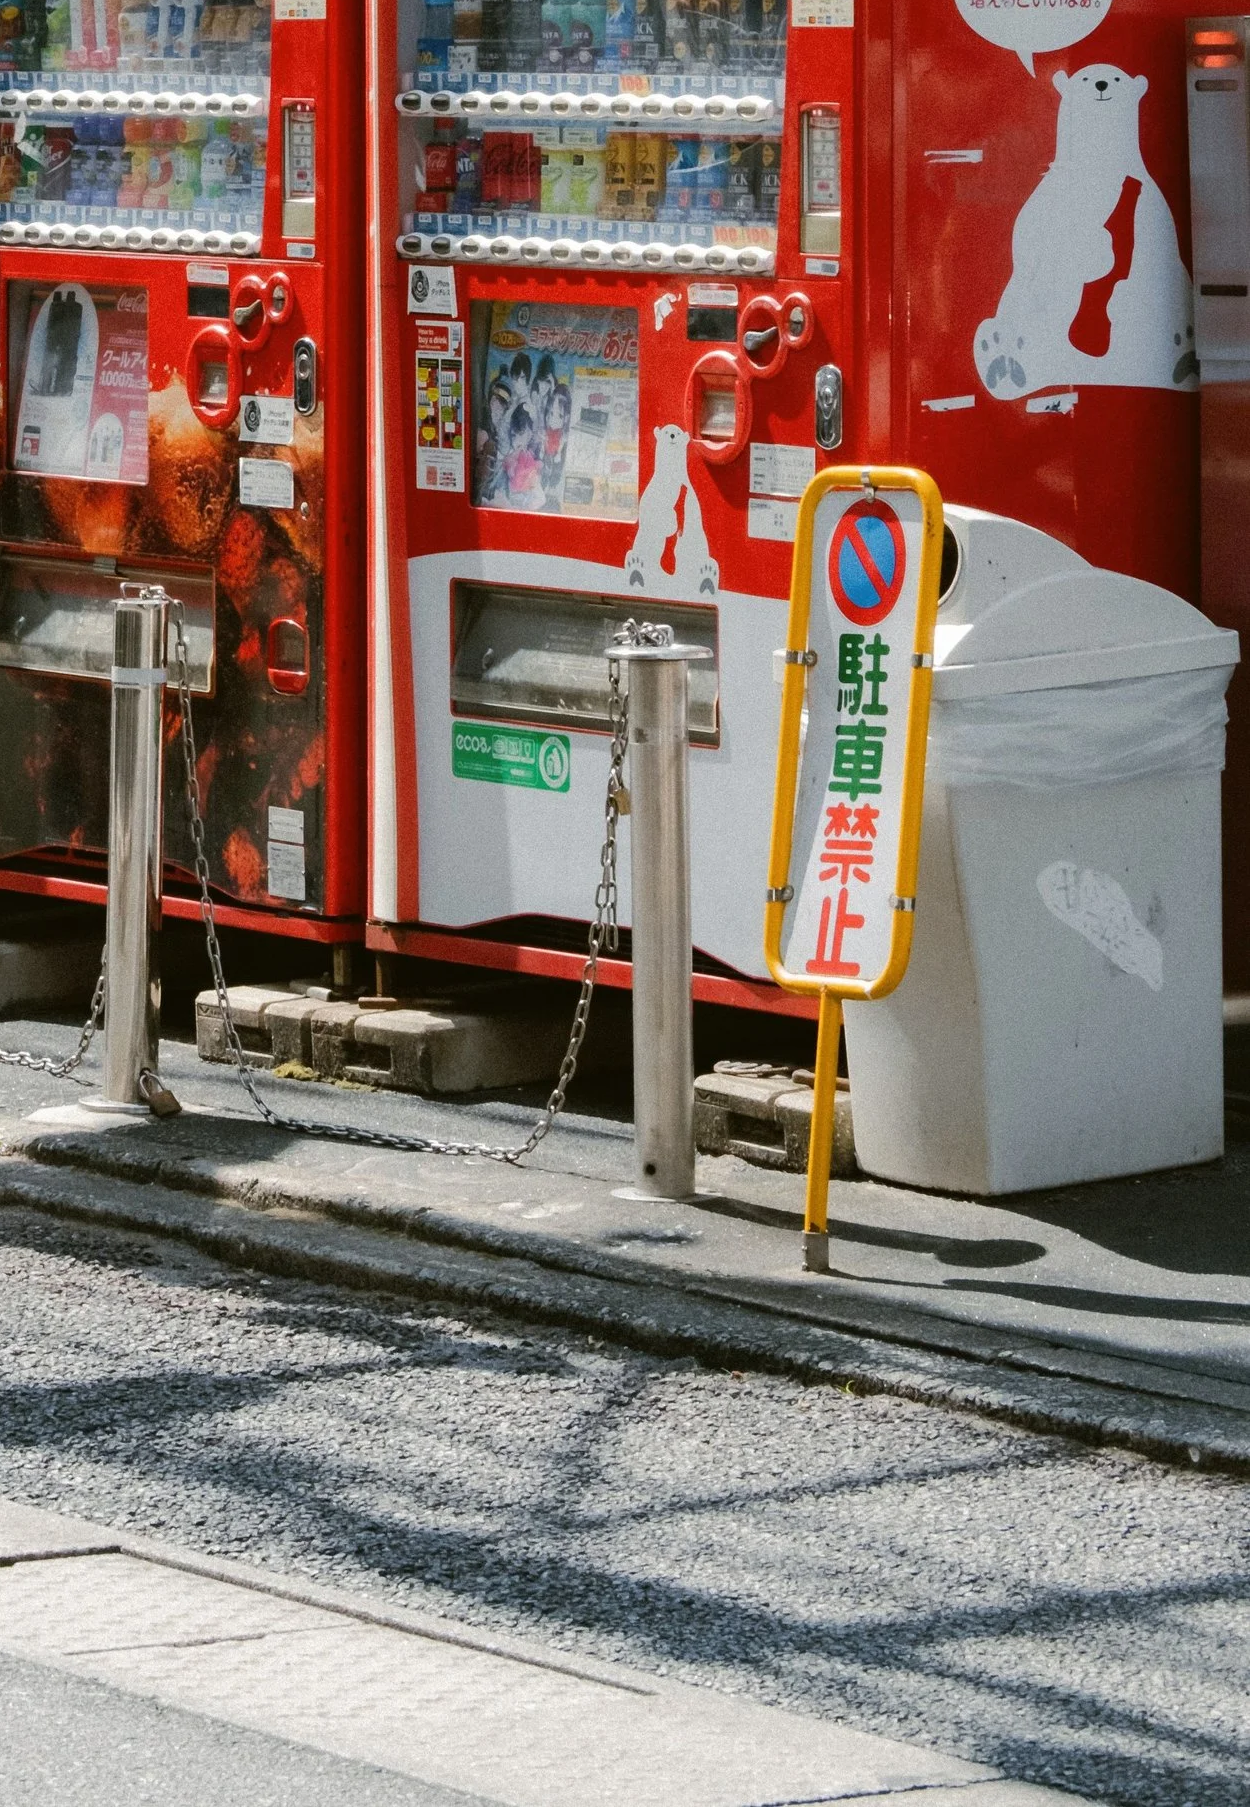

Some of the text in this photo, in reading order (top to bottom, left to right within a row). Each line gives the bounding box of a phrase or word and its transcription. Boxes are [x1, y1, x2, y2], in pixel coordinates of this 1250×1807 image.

[457, 156, 475, 174] NTA
[806, 632, 891, 978] 駐車禁止
